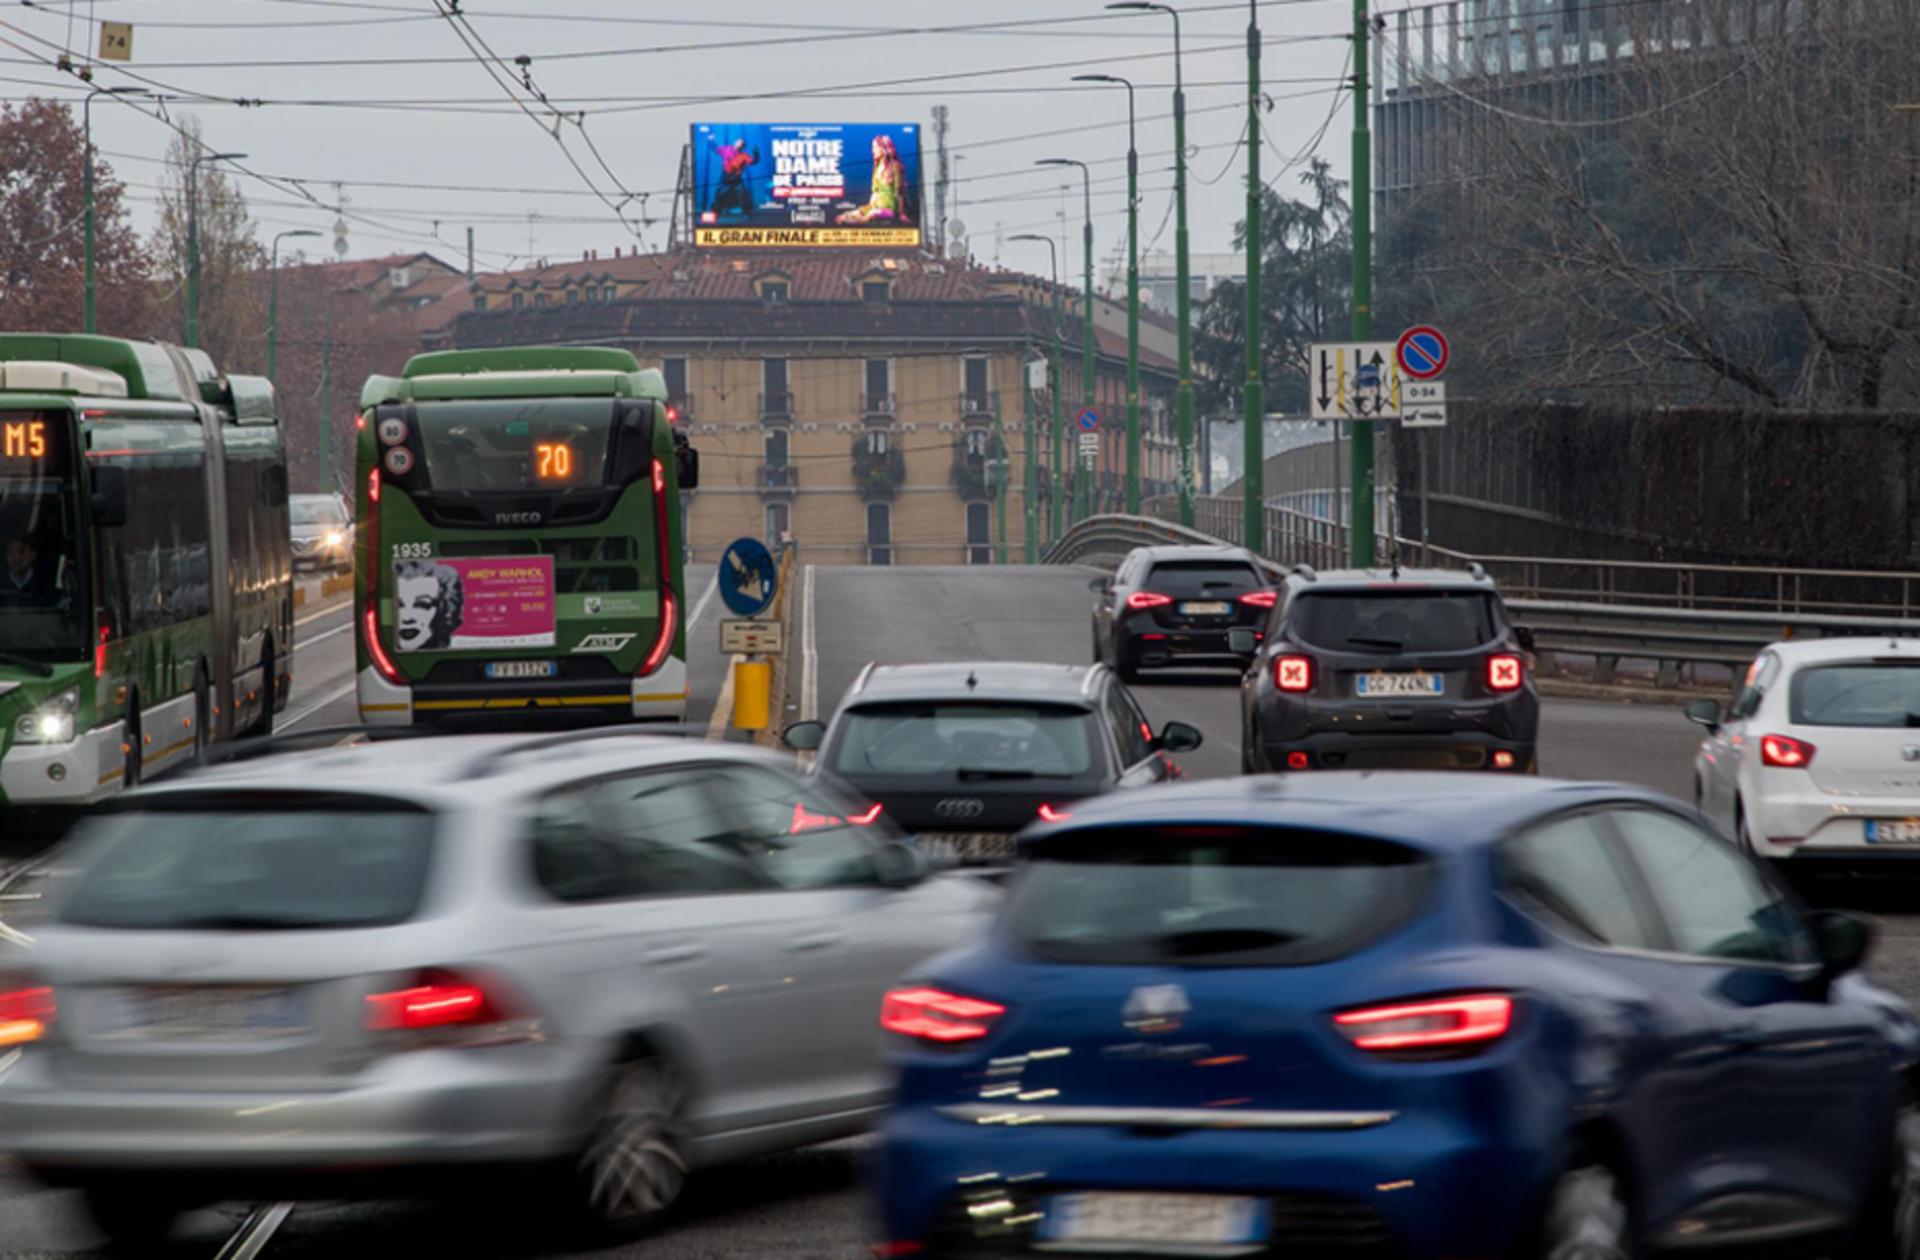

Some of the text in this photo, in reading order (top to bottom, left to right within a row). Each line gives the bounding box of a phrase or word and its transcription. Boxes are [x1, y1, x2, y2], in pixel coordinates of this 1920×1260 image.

[106, 34, 126, 48] 74
[772, 139, 844, 157] NOTRE
[776, 157, 841, 174] DAME
[773, 174, 793, 187] DE
[703, 230, 716, 243] IL
[719, 230, 762, 244] GRAN
[766, 230, 818, 243] FINALE
[1410, 387, 1436, 398] 0-24
[5, 421, 45, 457] M5
[536, 444, 570, 478] 70
[495, 511, 542, 523] IVECO
[391, 541, 433, 558] 1935
[467, 567, 545, 580] ANDY WARHOL
